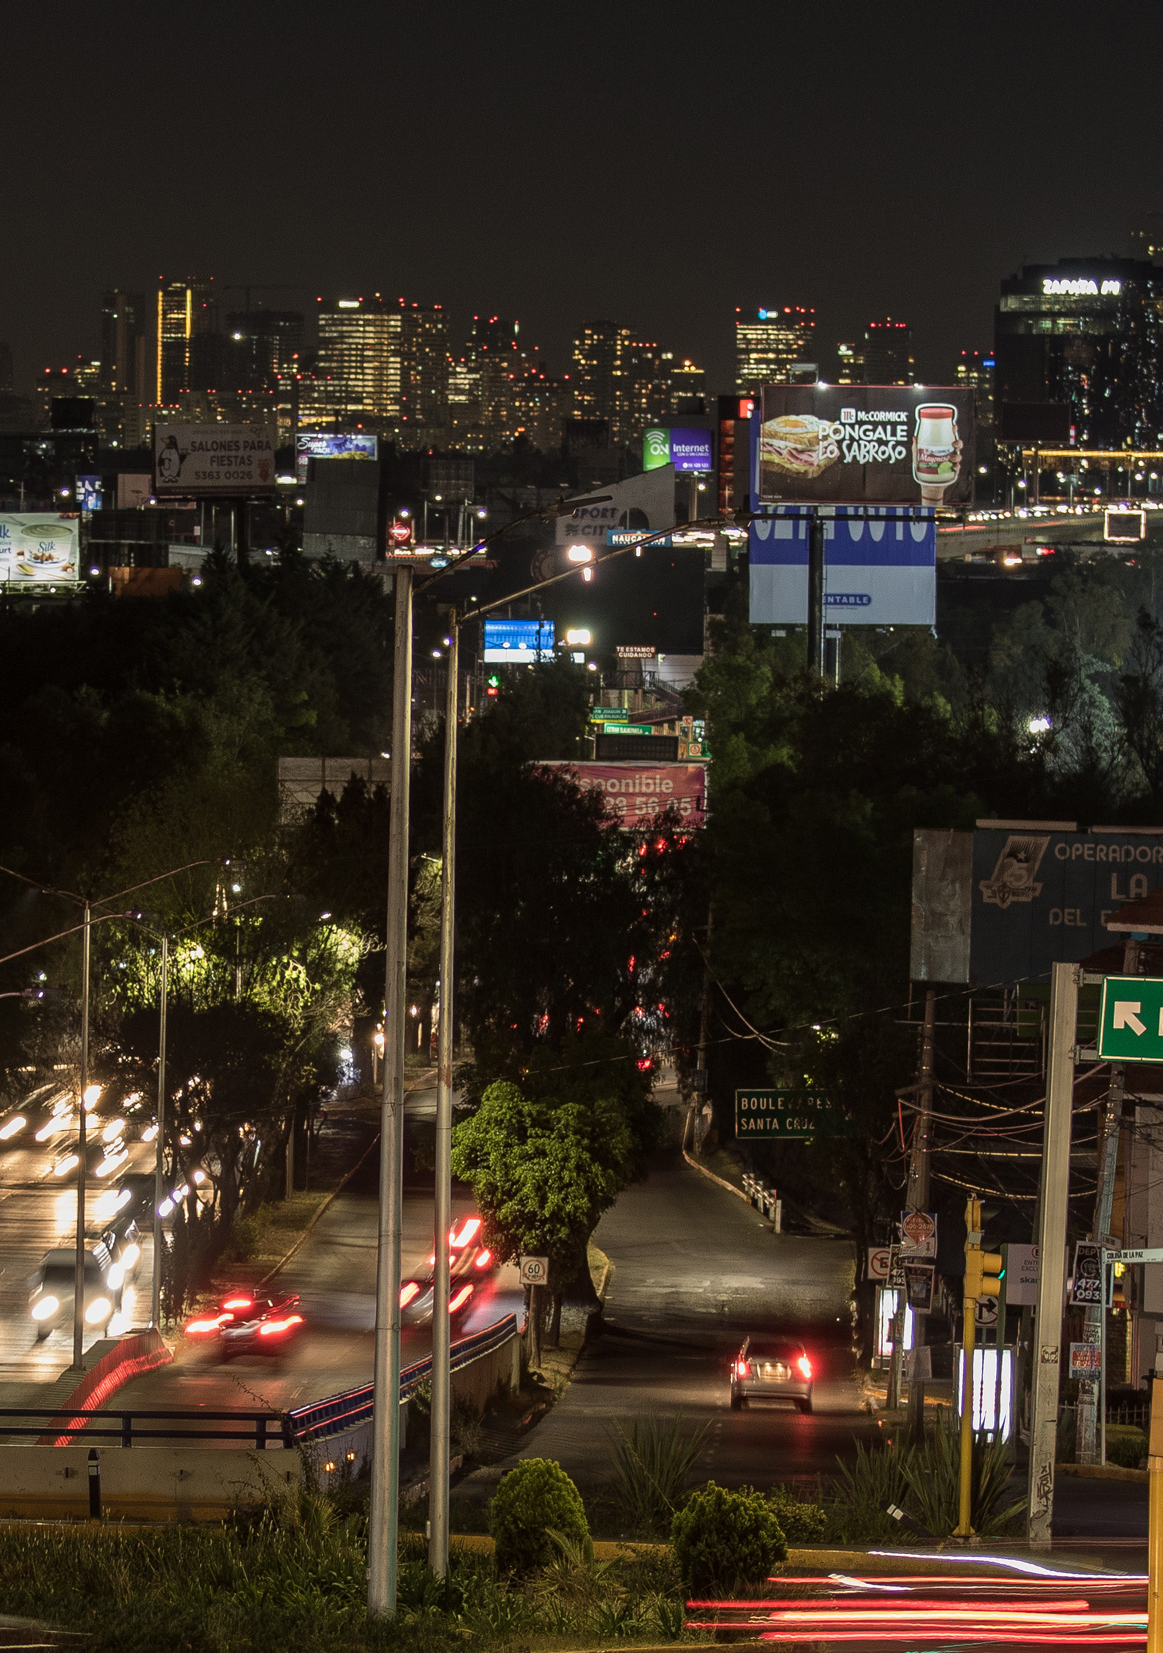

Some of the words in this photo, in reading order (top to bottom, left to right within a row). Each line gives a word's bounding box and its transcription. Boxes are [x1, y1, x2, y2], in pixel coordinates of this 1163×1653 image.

[857, 411, 908, 422] McCORMICK
[818, 420, 908, 441] PÓNGALE
[190, 441, 240, 452] SALONES
[243, 440, 272, 451] PARA
[673, 444, 709, 453] Internet
[818, 440, 838, 461] LO
[841, 440, 907, 464] SABROSO
[209, 455, 253, 467] FIESTAS
[194, 471, 221, 480] 5363
[224, 471, 253, 480] 0026
[611, 534, 666, 543] NAUCAAN
[823, 595, 869, 604] ENTABLE
[574, 775, 674, 794] sponible
[635, 797, 659, 816] 56
[1111, 873, 1148, 900] LA
[1049, 908, 1087, 927] DEL
[741, 1097, 832, 1110] BOULEES
[741, 1118, 779, 1130] SANTA
[1123, 1251, 1129, 1259] DE
[527, 1263, 540, 1274] 60
